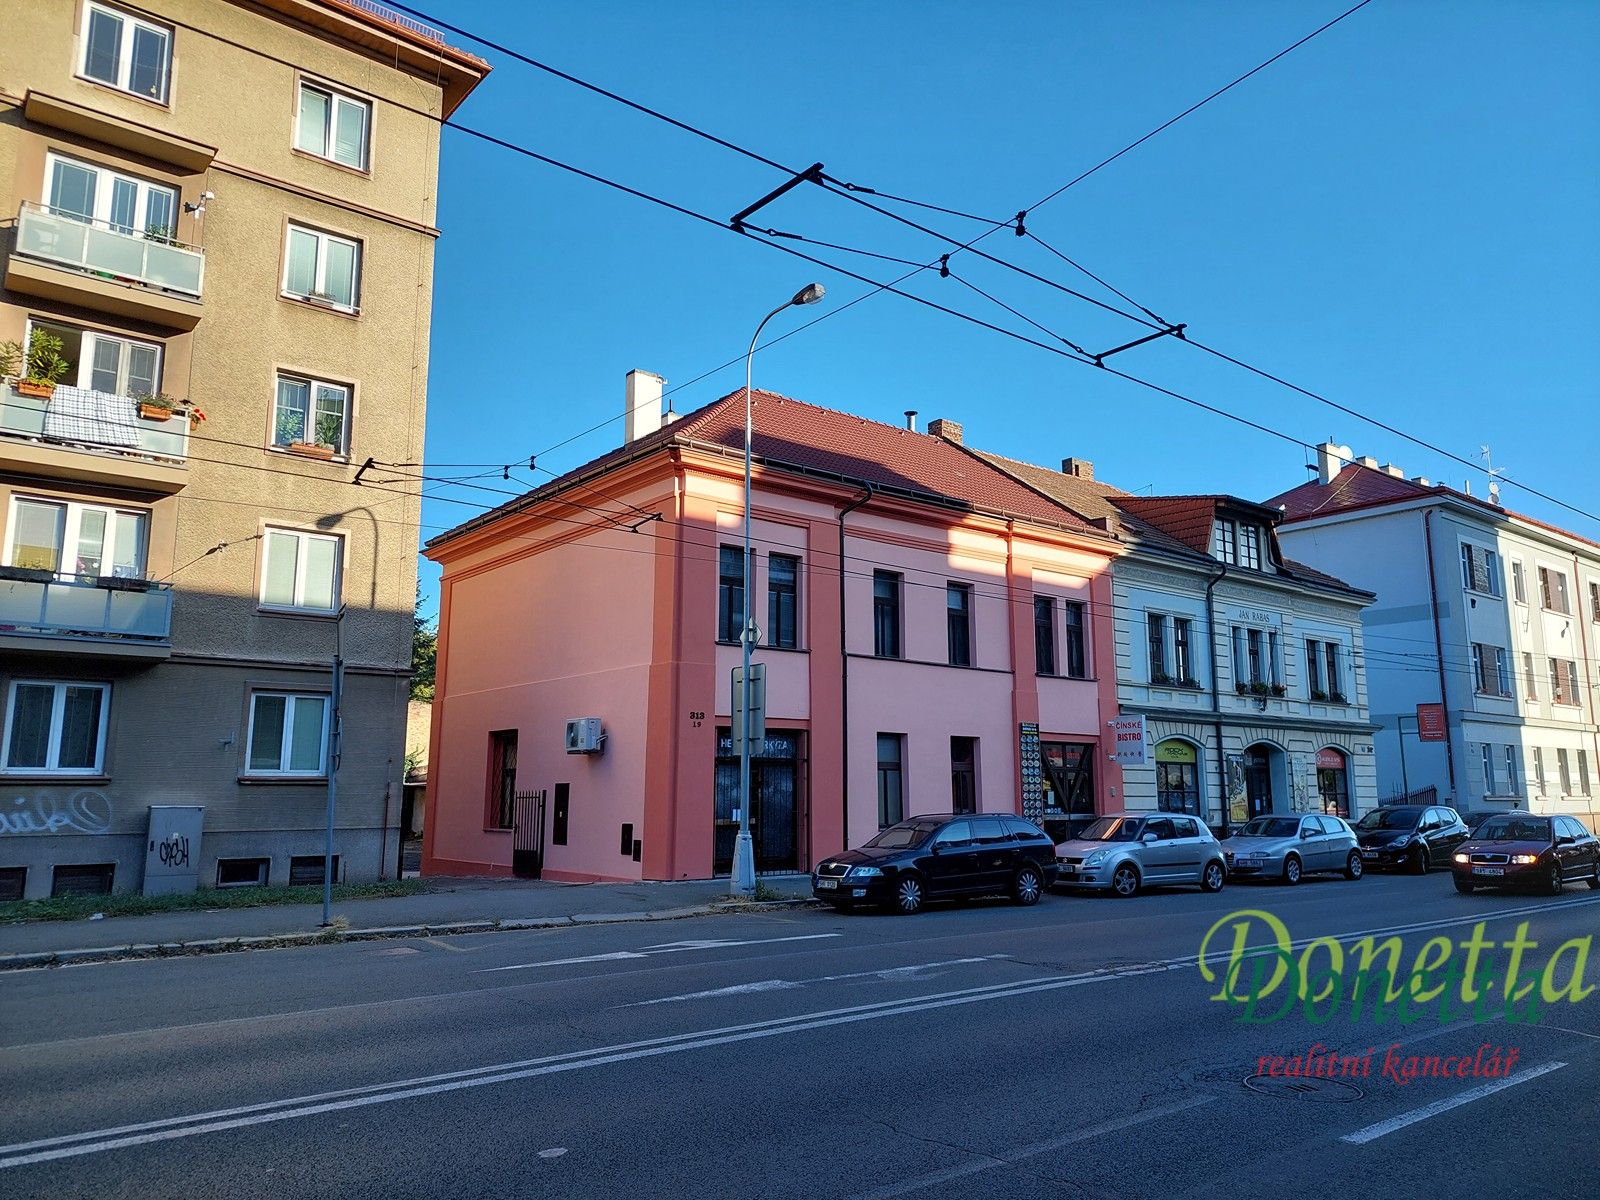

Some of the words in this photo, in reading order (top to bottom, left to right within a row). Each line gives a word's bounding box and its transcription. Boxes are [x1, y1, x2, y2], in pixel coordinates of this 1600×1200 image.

[689, 711, 705, 720] 313
[1115, 720, 1142, 730] ČÍNSKÉ
[1117, 732, 1142, 742] BISTRO
